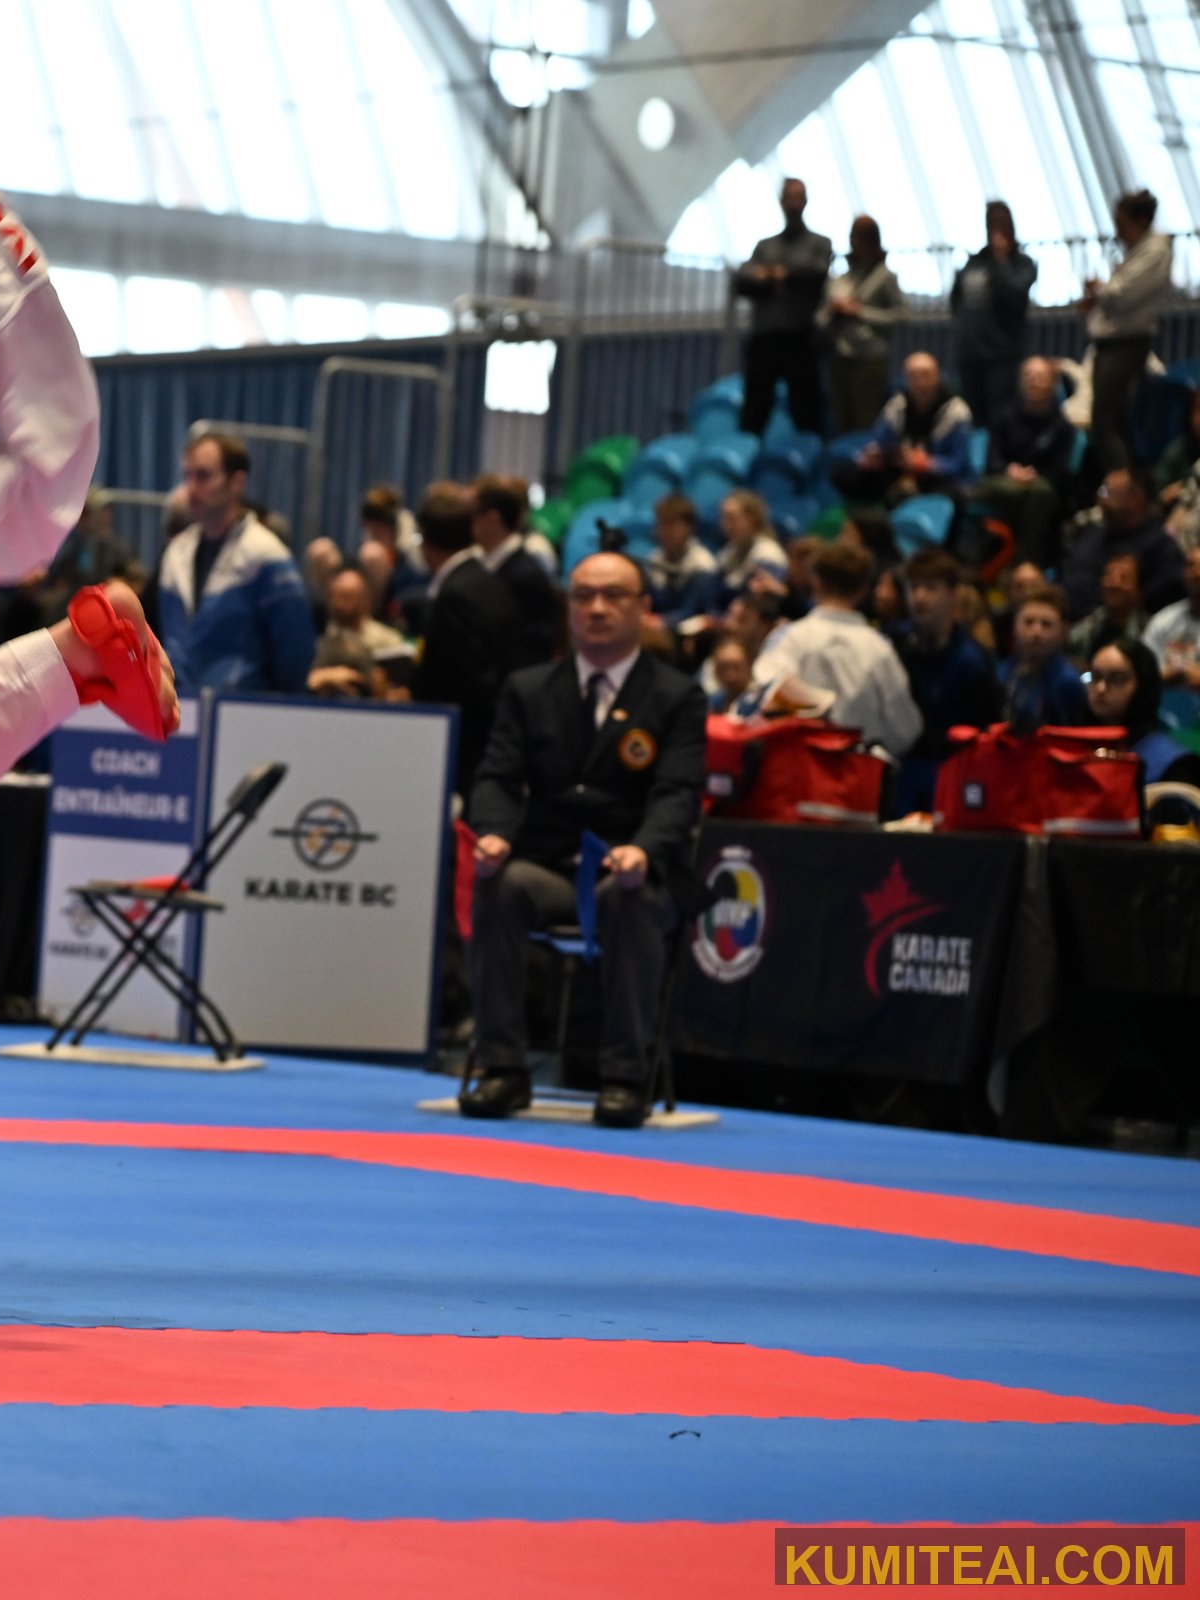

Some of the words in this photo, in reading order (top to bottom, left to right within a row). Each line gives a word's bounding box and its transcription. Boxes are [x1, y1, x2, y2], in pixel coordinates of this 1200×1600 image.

[91, 748, 161, 778] COACH
[245, 879, 352, 906] KARATE
[361, 882, 396, 908] BC
[892, 933, 972, 966] KARATE
[889, 963, 970, 995] CANADA
